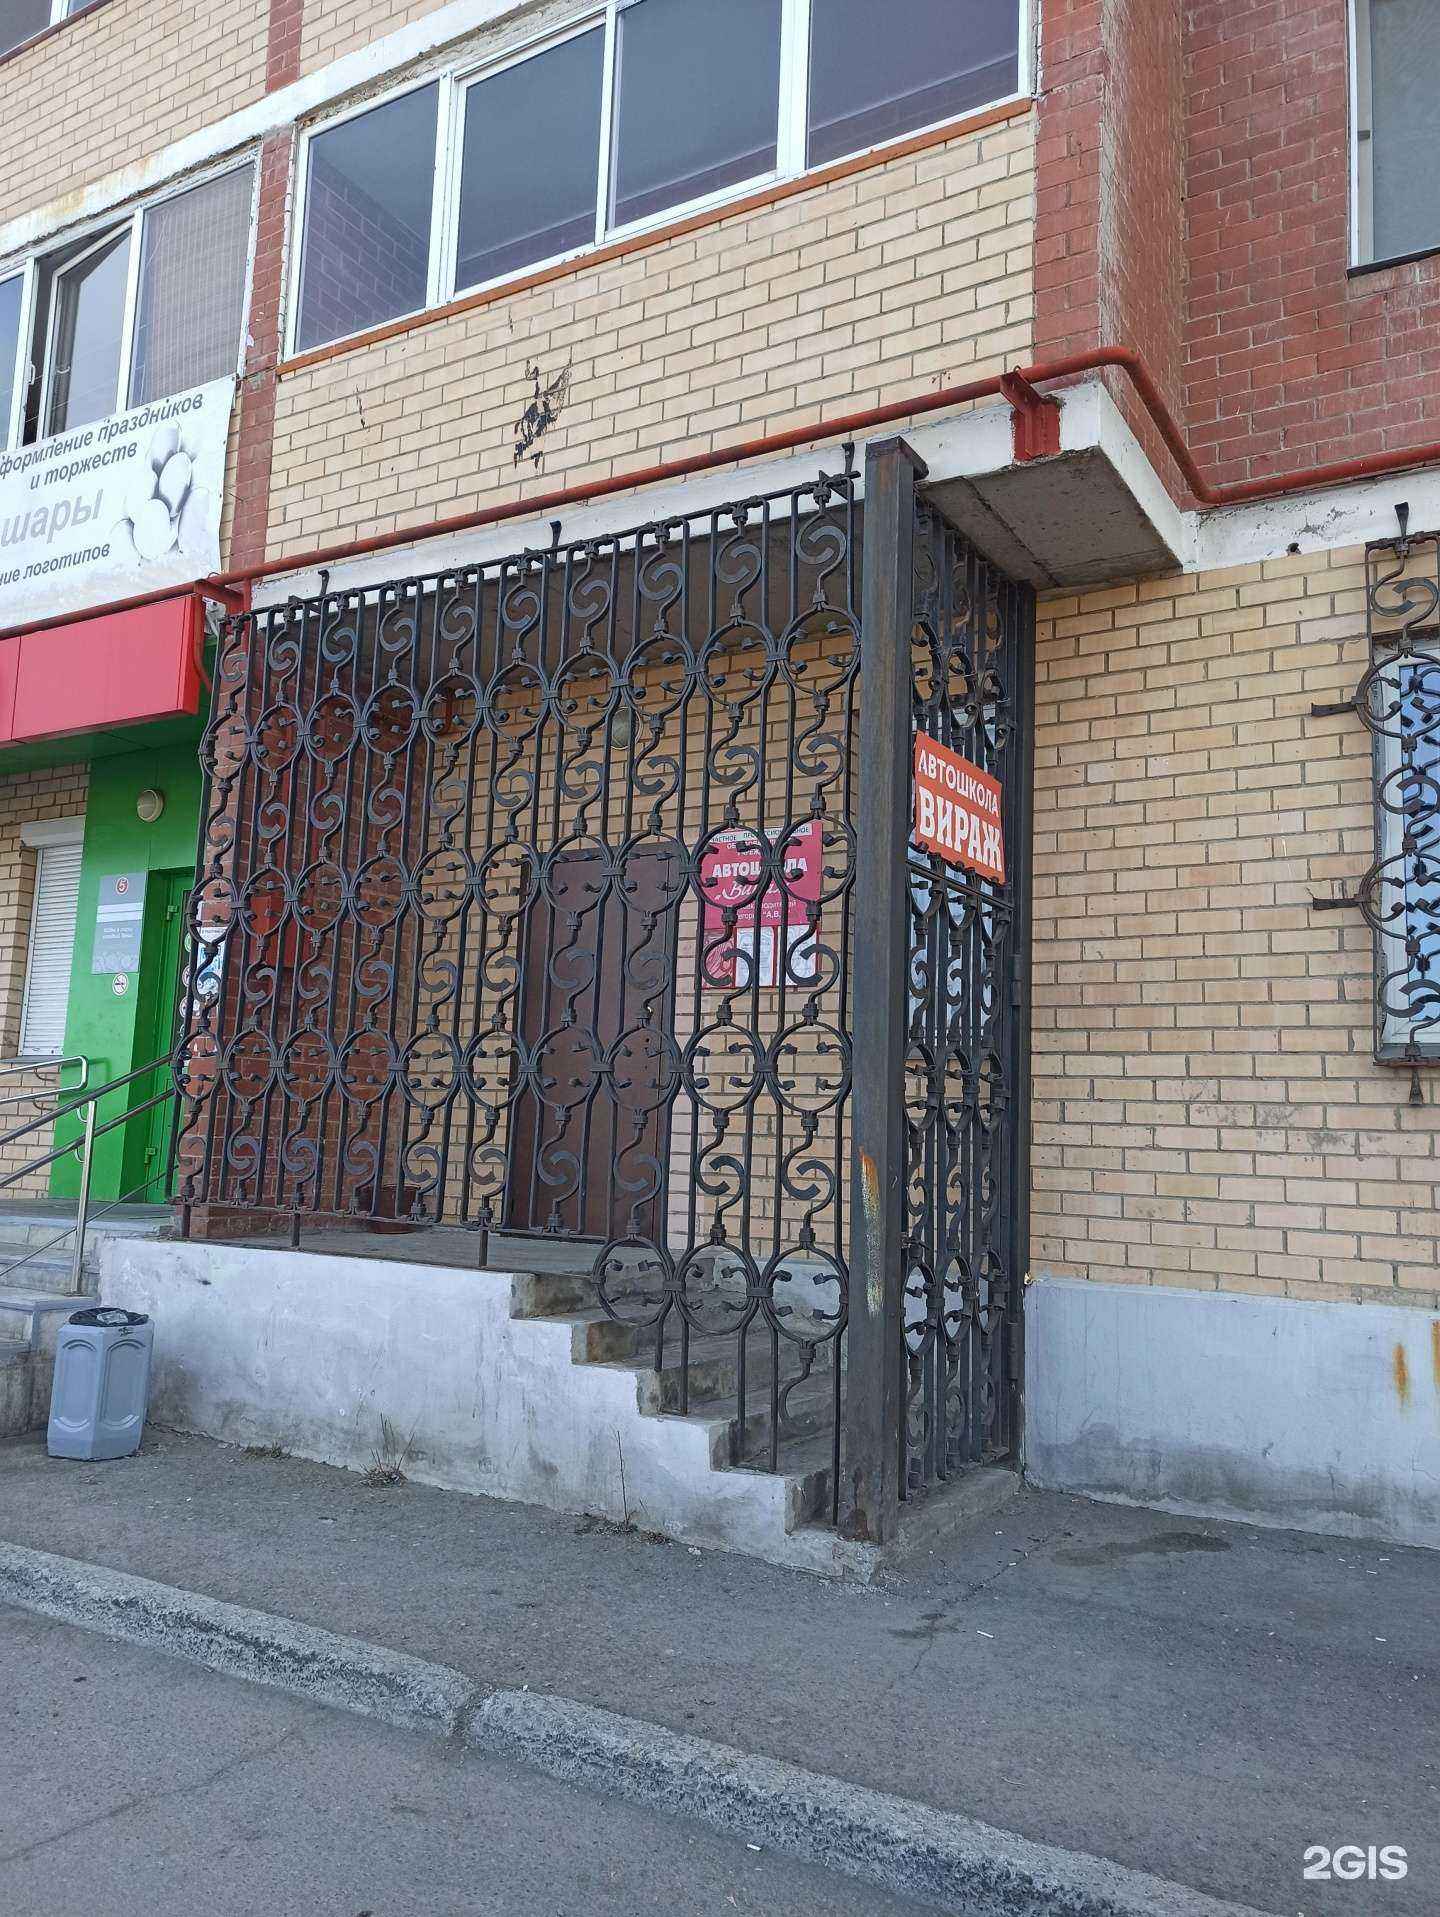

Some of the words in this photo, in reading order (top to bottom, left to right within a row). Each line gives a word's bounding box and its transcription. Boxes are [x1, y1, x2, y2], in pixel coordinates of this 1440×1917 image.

[98, 393, 204, 442] праздников
[30, 474, 41, 490] и
[44, 441, 138, 486] торжеств
[0, 488, 103, 548] шары
[22, 543, 111, 580] логотипов
[918, 749, 999, 818] АВТОШКОЛА
[918, 785, 1003, 872] ВИРАЖ
[712, 857, 808, 878] АВТОШЛА
